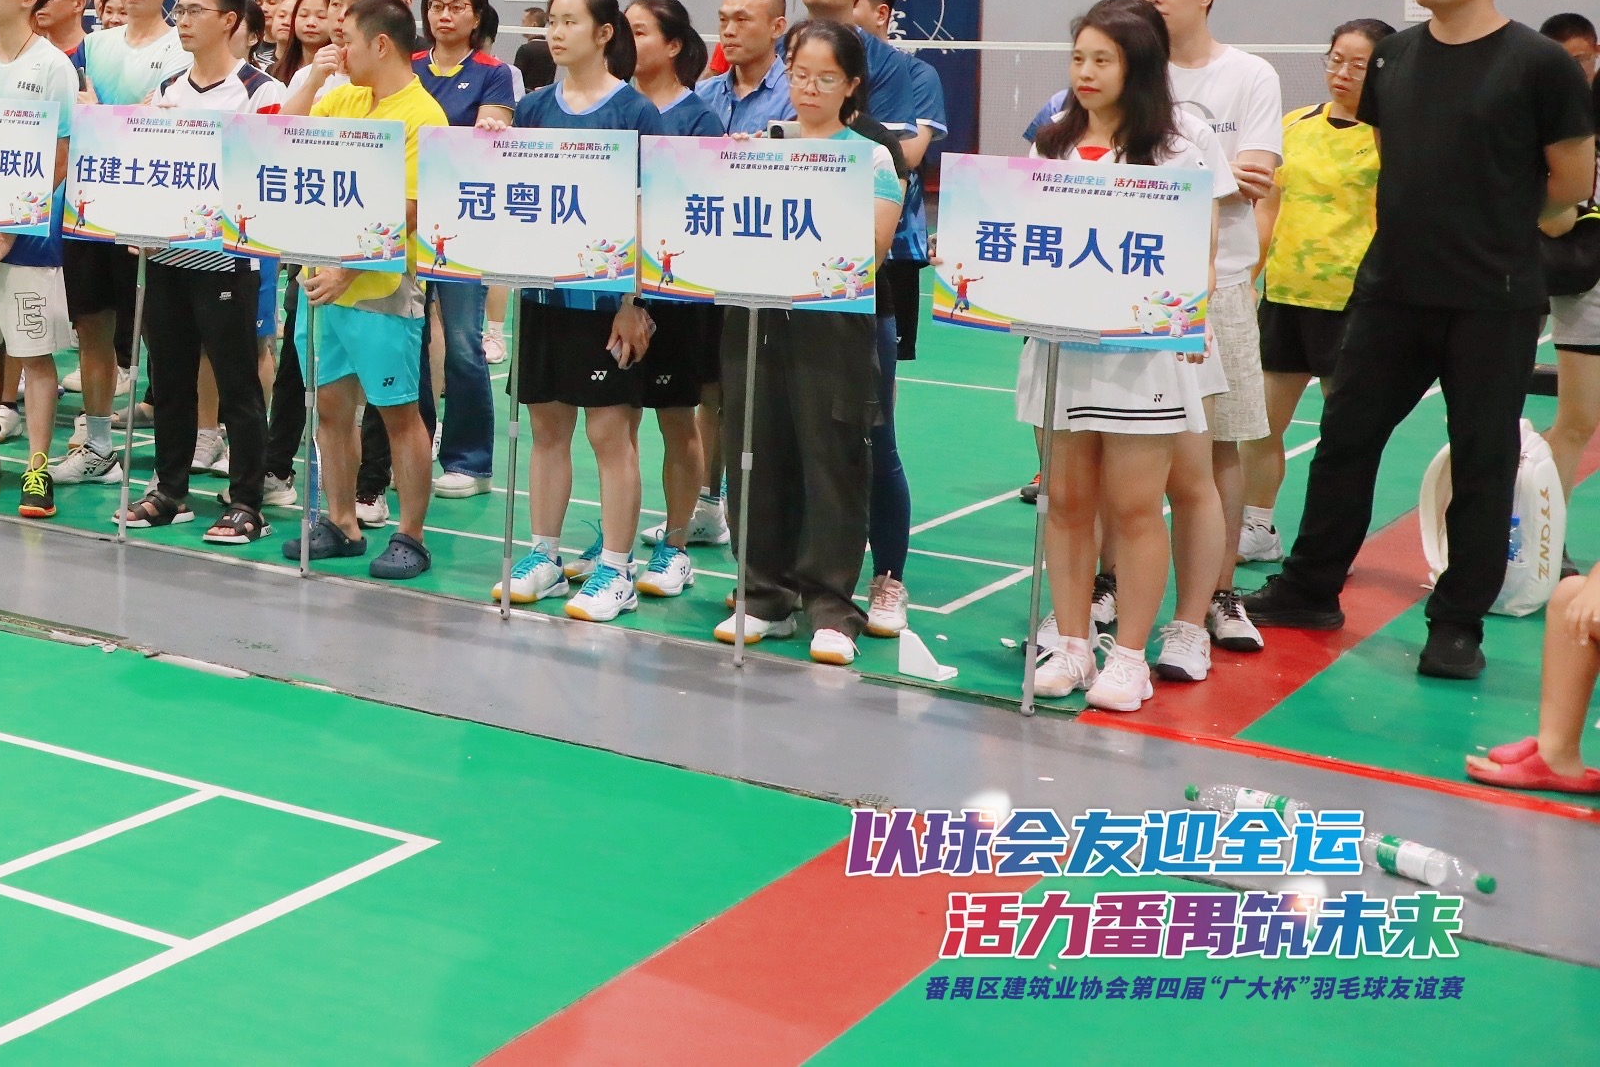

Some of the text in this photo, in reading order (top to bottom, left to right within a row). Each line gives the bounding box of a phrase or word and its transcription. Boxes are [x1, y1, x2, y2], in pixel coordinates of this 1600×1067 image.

[75, 154, 221, 192] 住建土发联队
[256, 164, 365, 210] 信投队
[457, 181, 587, 226] 冠粤队
[684, 193, 822, 243] 新业队
[975, 220, 1166, 278] 番禺人保
